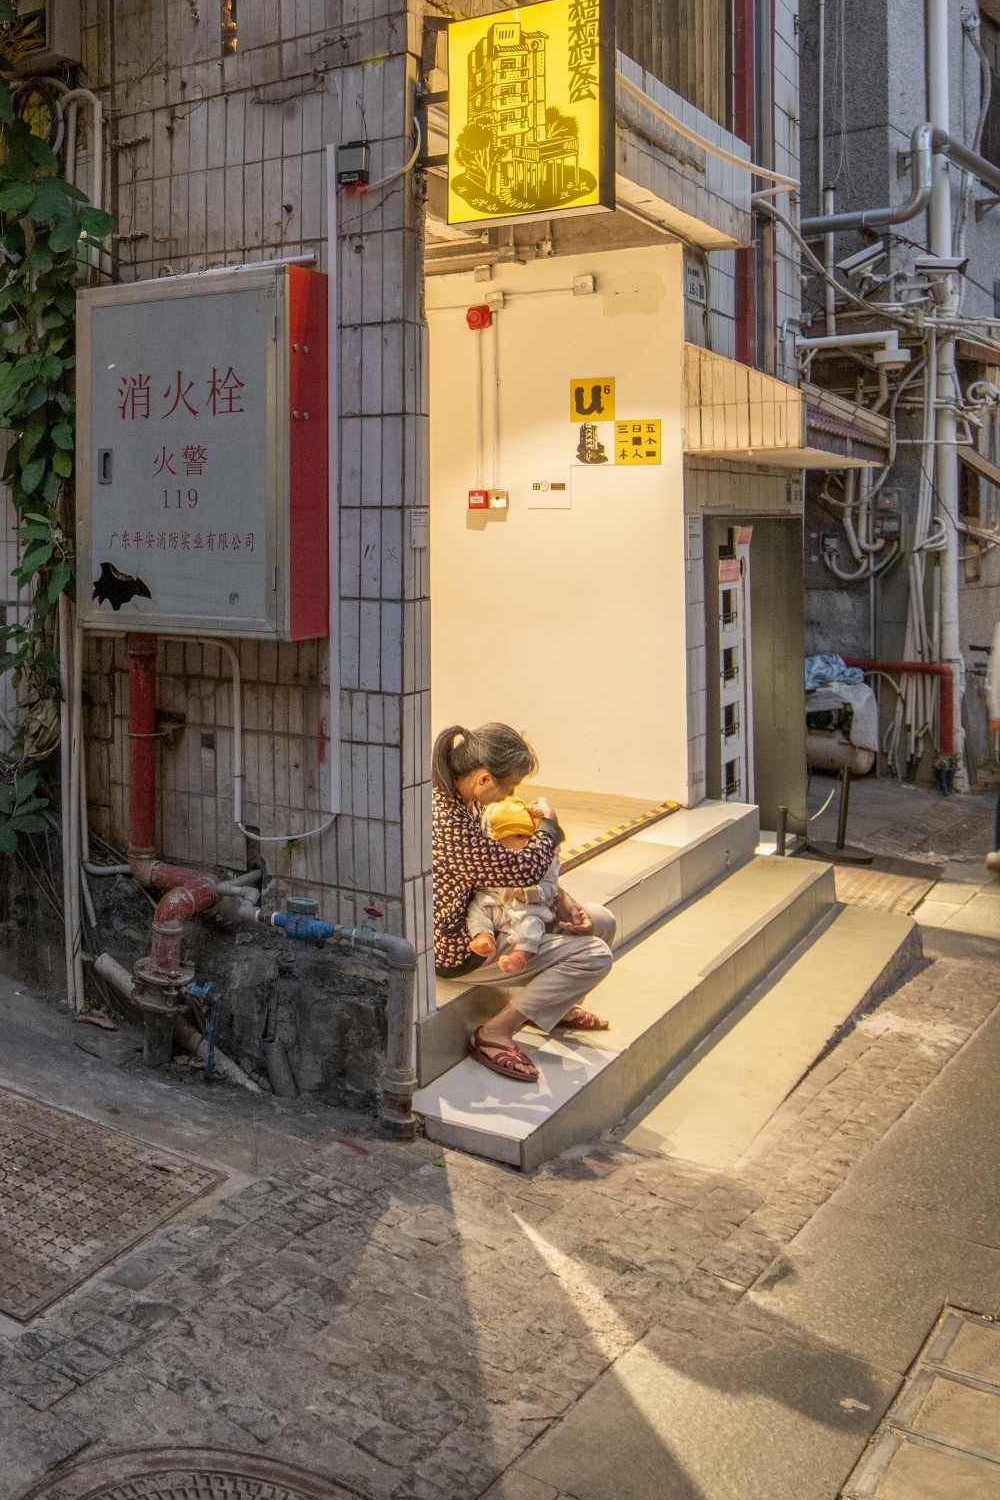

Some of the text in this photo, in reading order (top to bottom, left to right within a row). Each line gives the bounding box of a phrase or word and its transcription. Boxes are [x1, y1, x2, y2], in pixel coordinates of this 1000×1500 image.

[117, 366, 246, 421] 消火栓
[151, 444, 208, 478] 火警
[162, 488, 199, 509] 119
[109, 530, 255, 552] 广东平安消防实业有限公司
